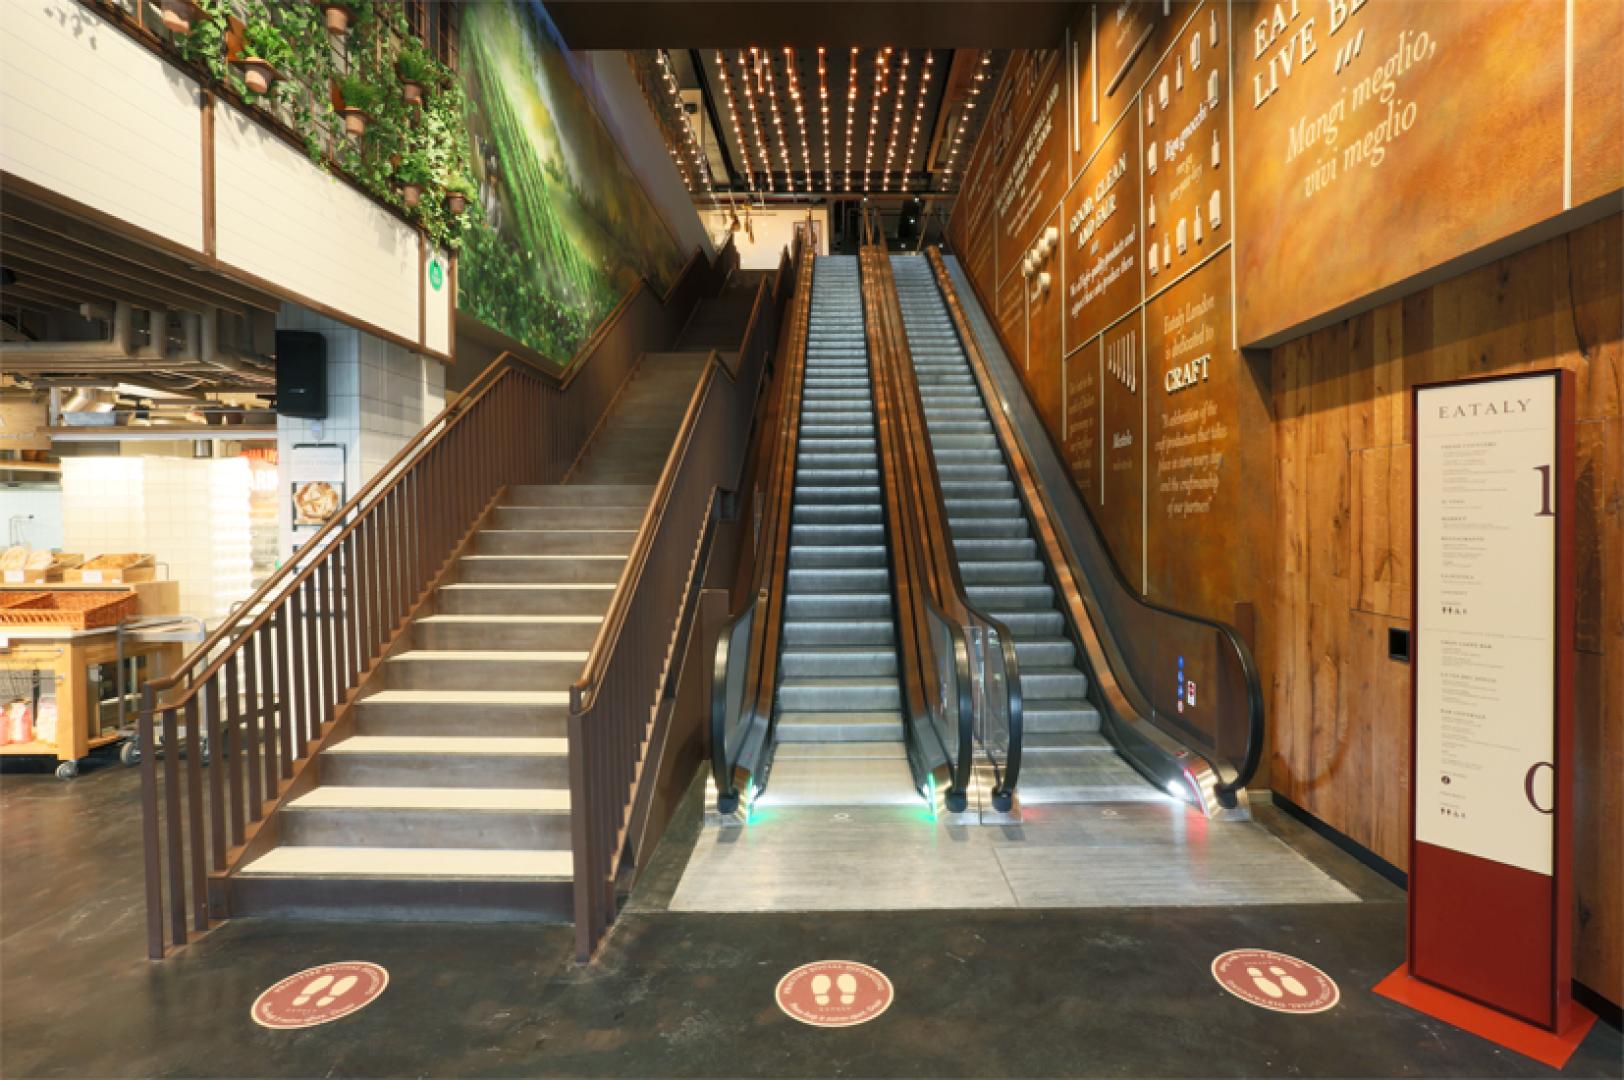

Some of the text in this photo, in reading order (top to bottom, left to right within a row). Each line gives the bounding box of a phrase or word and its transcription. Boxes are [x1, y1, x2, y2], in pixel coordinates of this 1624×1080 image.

[1253, 16, 1318, 110] LIVE
[1286, 29, 1437, 164] Mangi meglio,
[1304, 98, 1417, 198] vivi meglio
[1095, 152, 1127, 204] CLEAN
[1164, 353, 1212, 393] CRAFT
[1438, 398, 1532, 419] EATALY
[1532, 464, 1556, 517] 1
